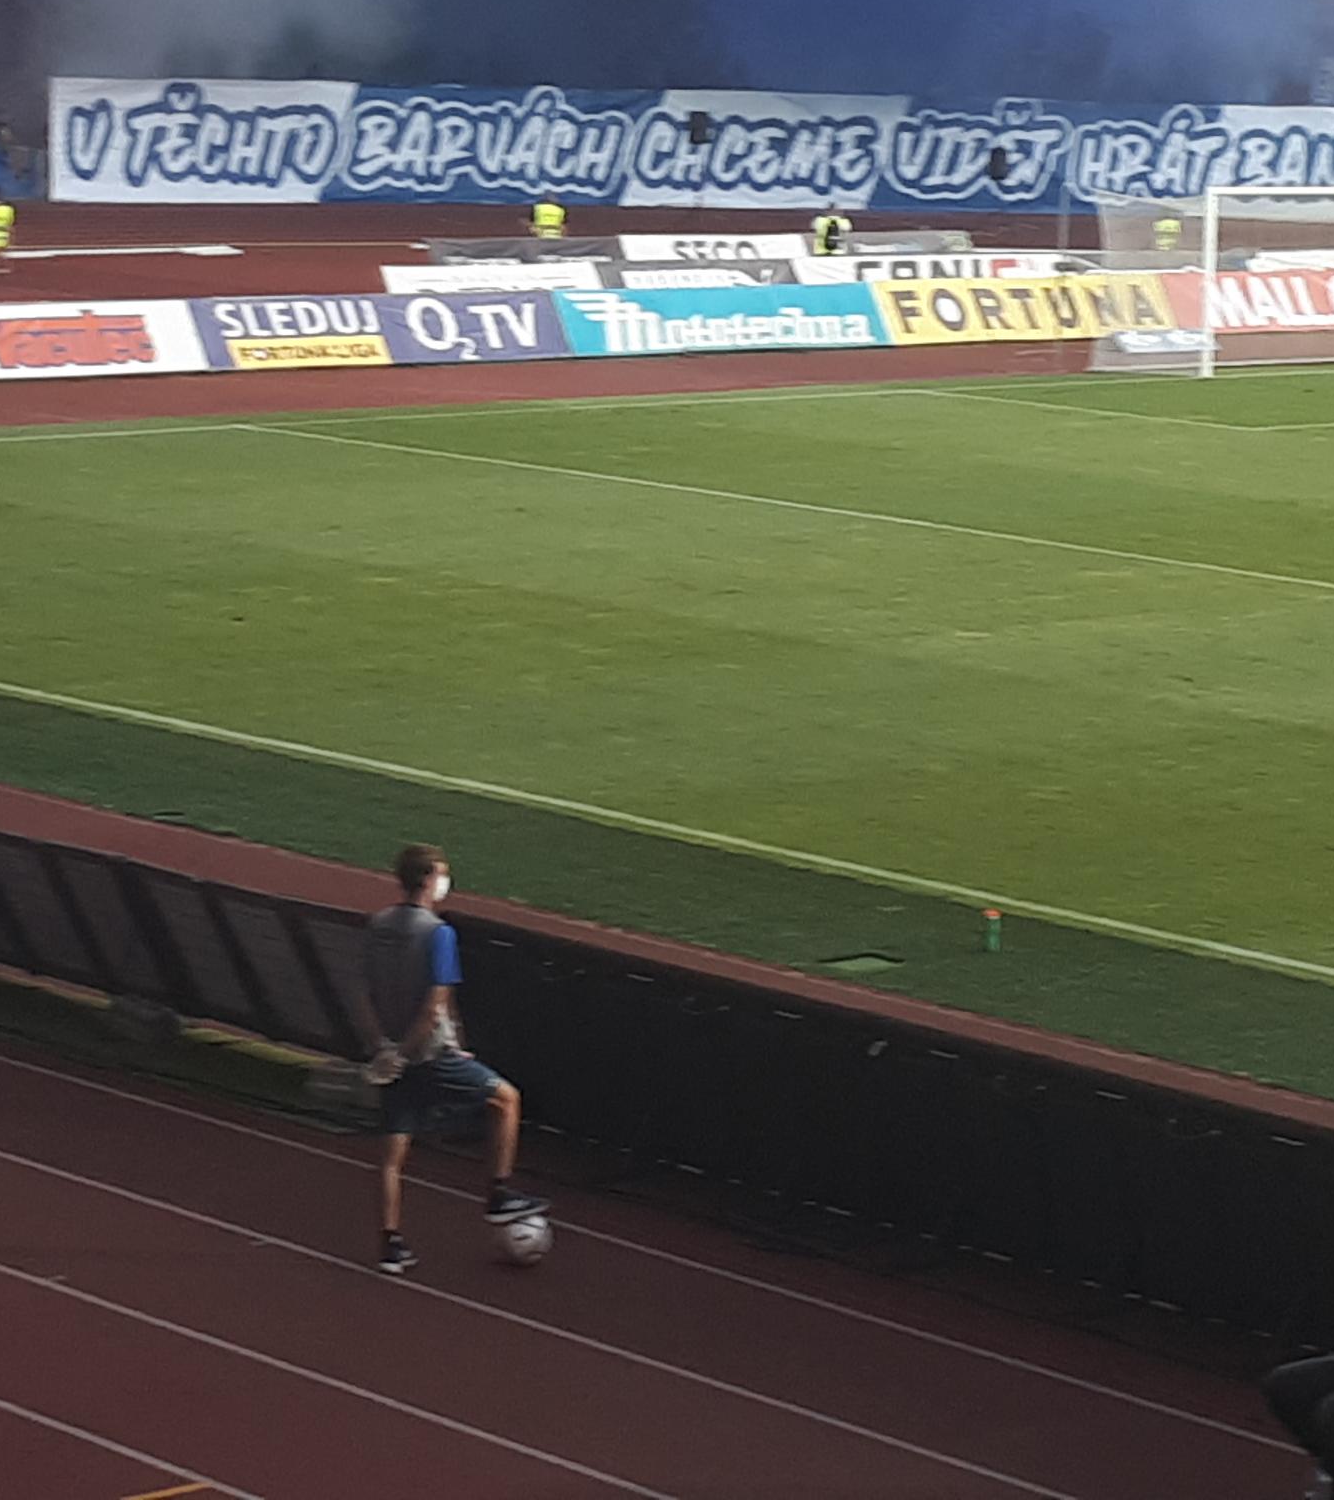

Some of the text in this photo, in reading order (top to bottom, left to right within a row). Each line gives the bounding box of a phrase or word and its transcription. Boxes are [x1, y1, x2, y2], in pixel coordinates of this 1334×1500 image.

[69, 98, 114, 181] V
[125, 82, 338, 187] TĚCHTO
[351, 97, 623, 184] BARVÁCH
[635, 111, 879, 194] CHCEME
[1077, 112, 1229, 197] HRÁT
[214, 299, 381, 338] SLEDUJ
[468, 303, 538, 350] TV
[886, 284, 1166, 334] FORTUNA
